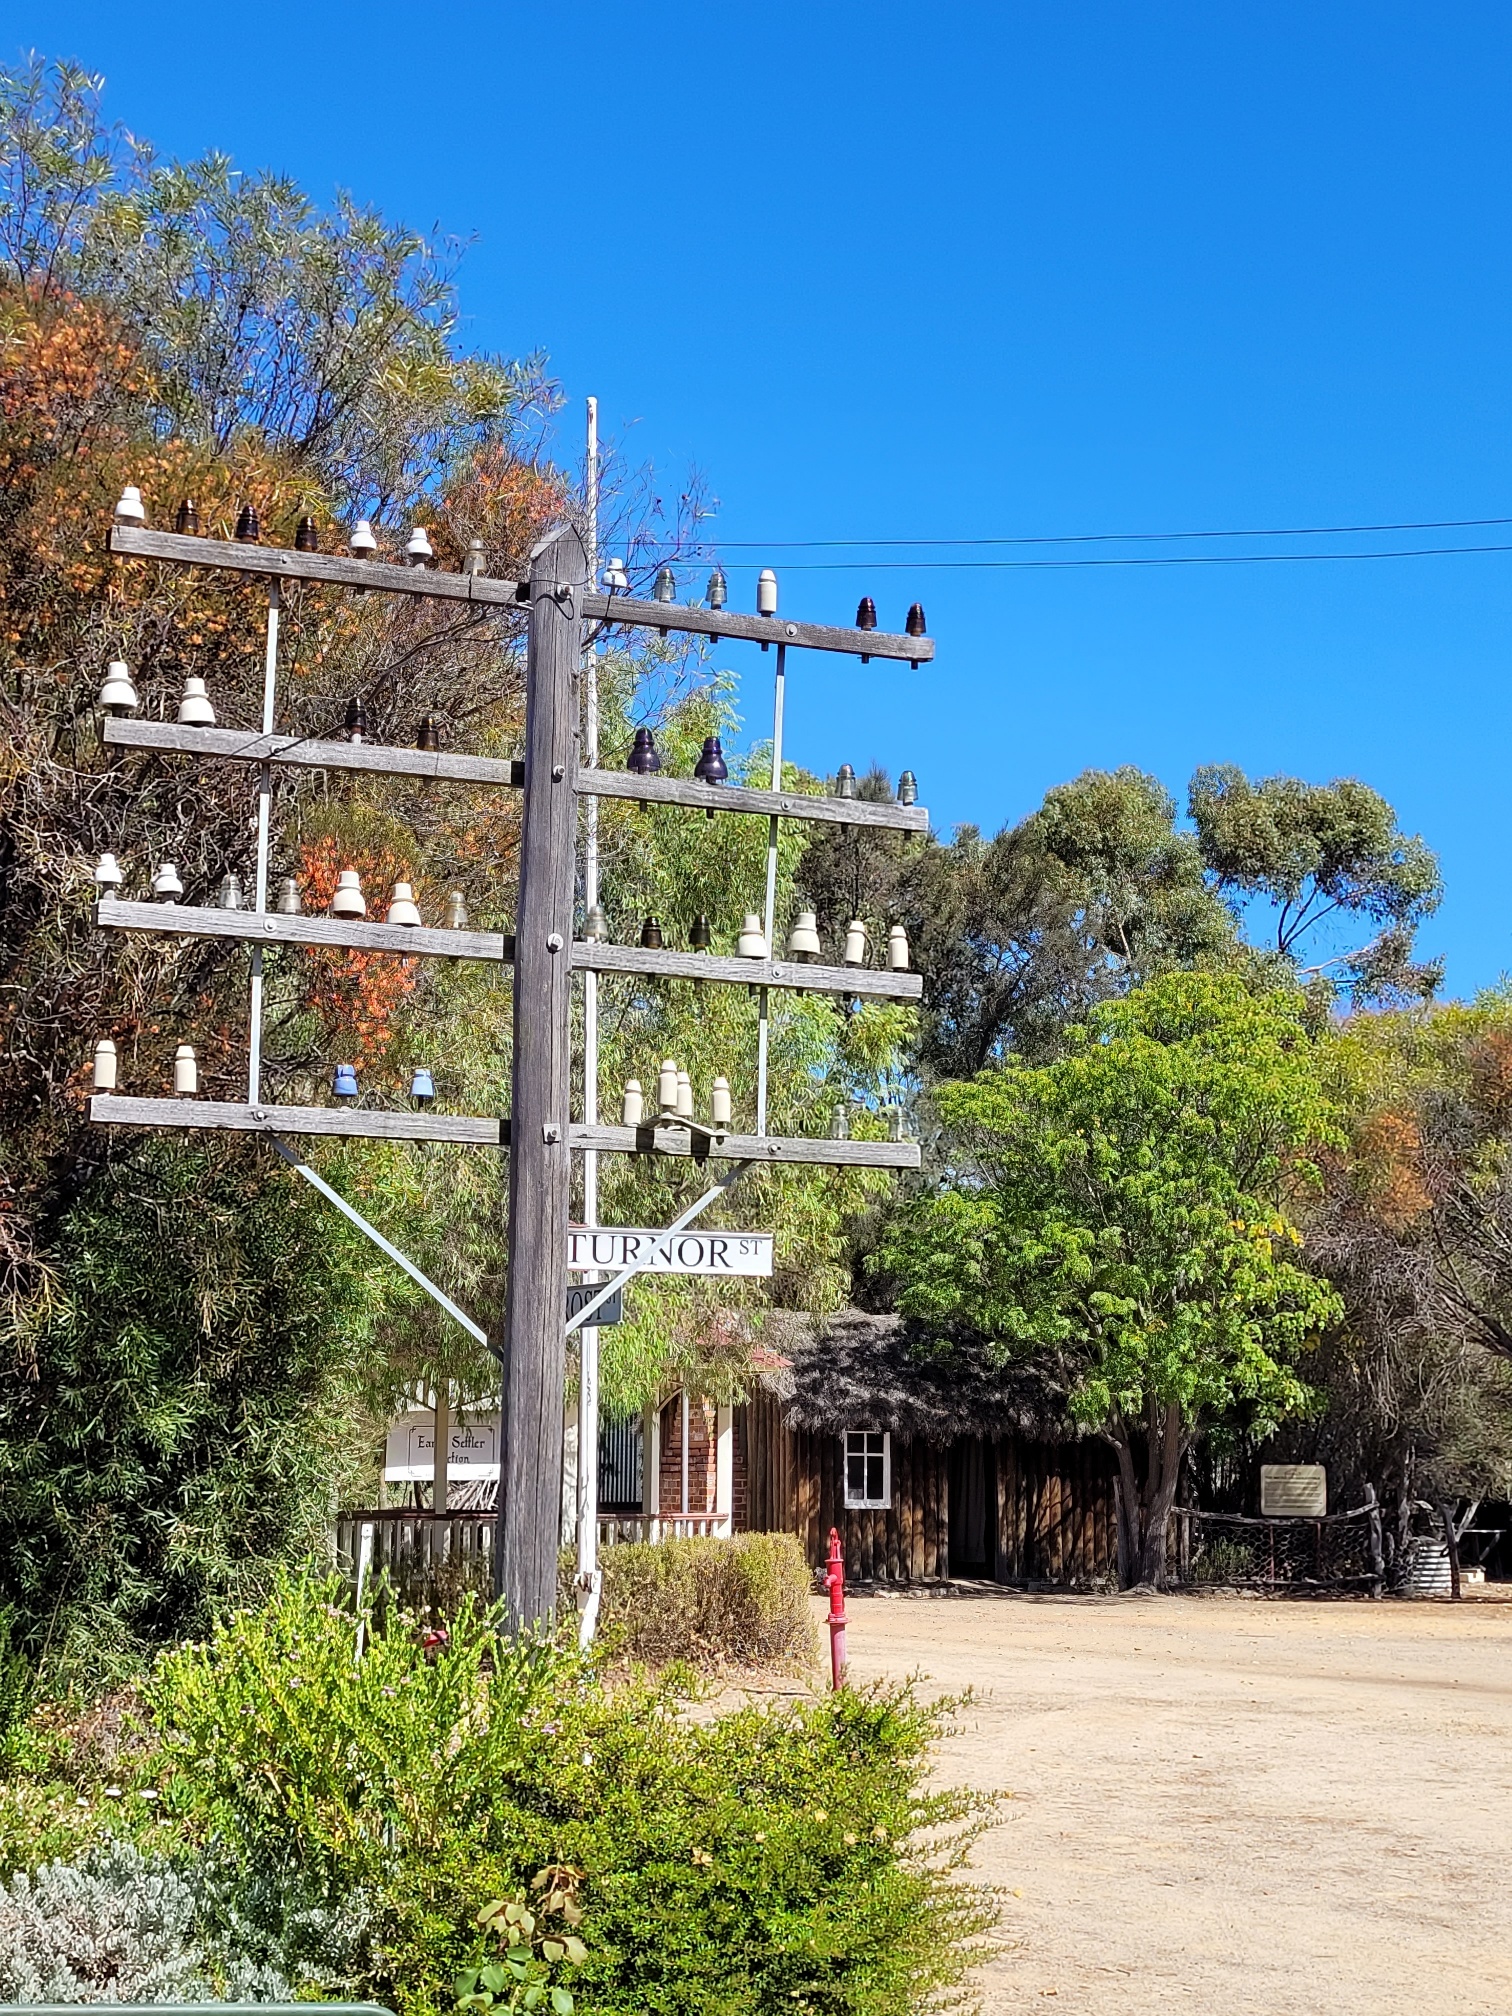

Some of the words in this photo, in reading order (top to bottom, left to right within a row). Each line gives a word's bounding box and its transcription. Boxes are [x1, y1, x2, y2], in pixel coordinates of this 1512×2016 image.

[568, 1233, 733, 1268] TURNOR
[739, 1239, 762, 1255] ST
[451, 1435, 485, 1448] Settler
[447, 1451, 470, 1464] ction
